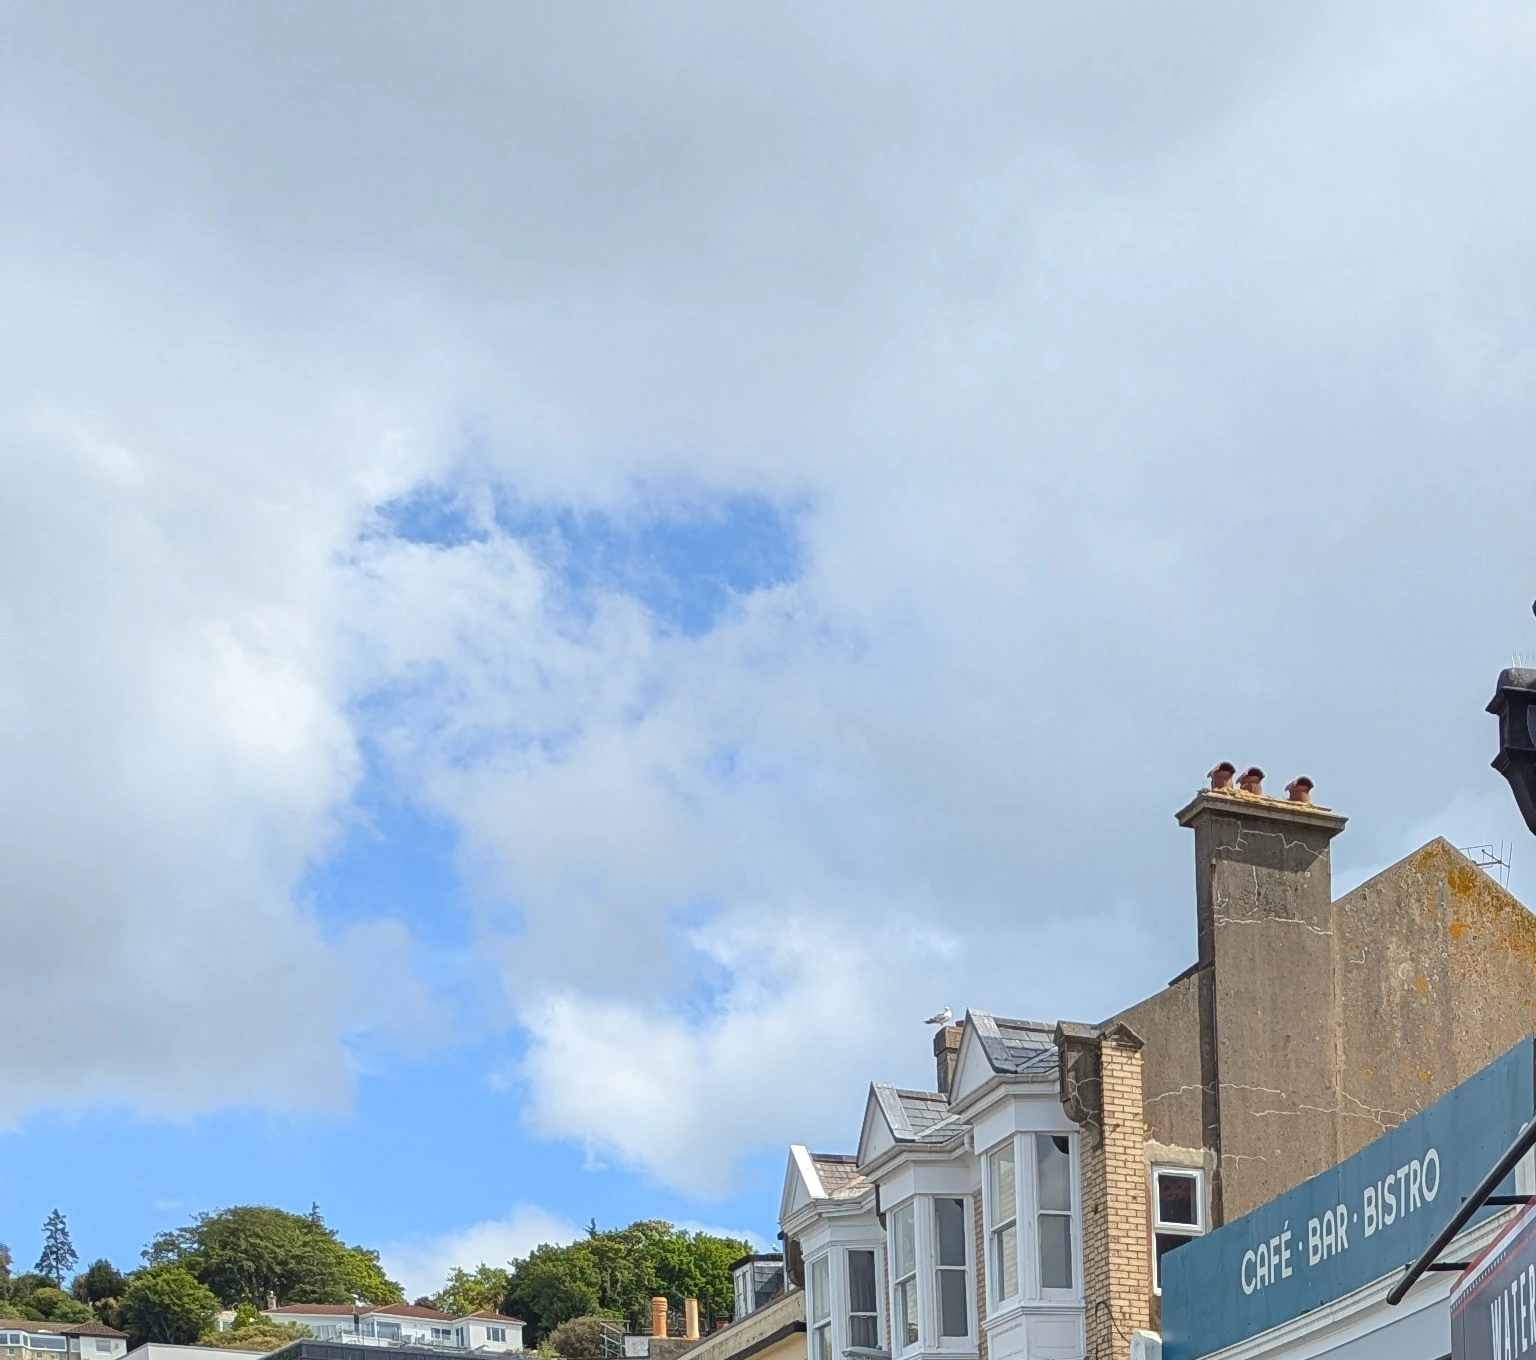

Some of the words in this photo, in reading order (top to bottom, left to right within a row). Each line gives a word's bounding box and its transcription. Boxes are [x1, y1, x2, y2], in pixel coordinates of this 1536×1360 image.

[1241, 1220, 1293, 1295] CAFÉ
[1308, 1203, 1349, 1267] BAR
[1363, 1147, 1440, 1239] BISTRO
